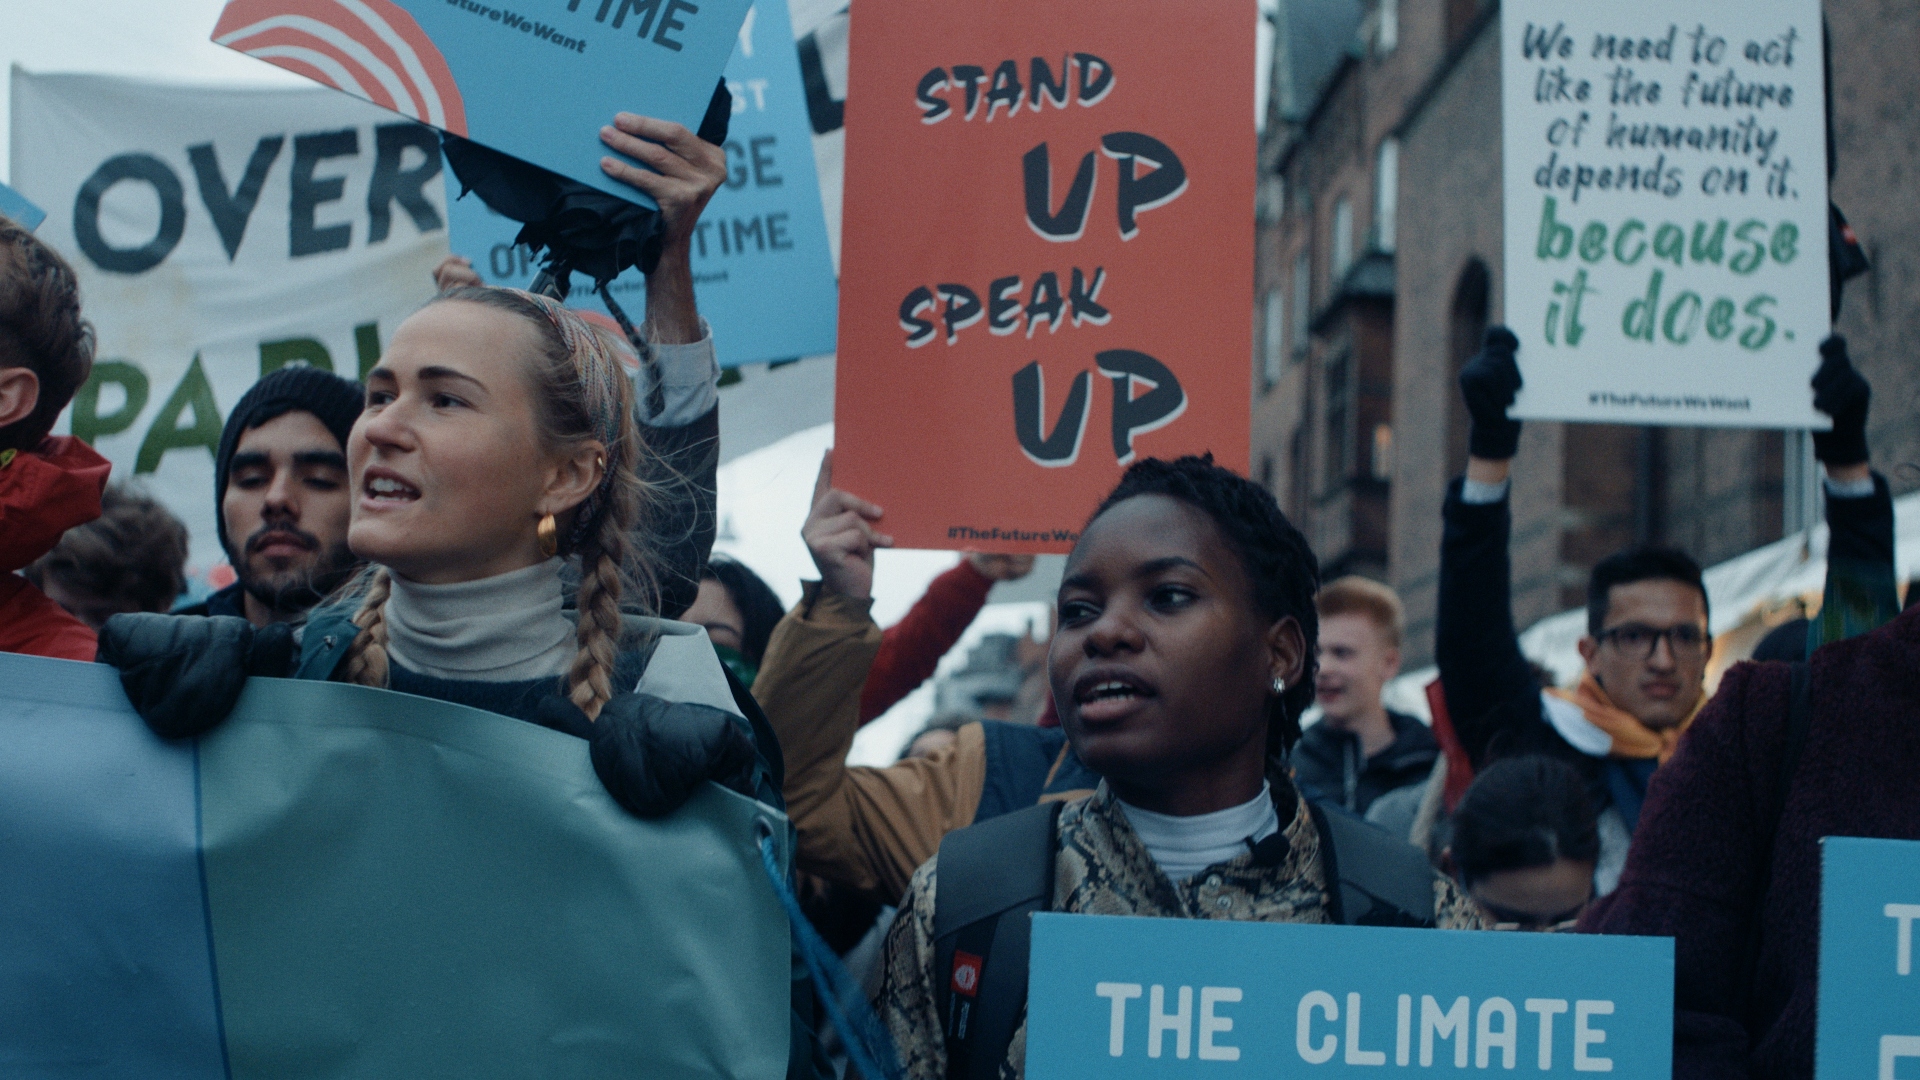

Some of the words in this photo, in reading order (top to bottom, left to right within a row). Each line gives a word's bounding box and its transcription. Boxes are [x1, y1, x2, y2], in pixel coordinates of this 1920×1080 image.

[447, 0, 587, 53] utureWeWant
[1521, 22, 1574, 60] We
[1591, 24, 1677, 63] need
[1687, 25, 1727, 65] to
[1743, 26, 1798, 66] act
[915, 53, 1115, 124] STAND
[1534, 66, 1593, 104] like
[1604, 65, 1662, 106] the
[1681, 69, 1794, 109] future
[1545, 111, 1590, 146] of
[1605, 112, 1778, 167] humanity
[1022, 131, 1188, 242] UP
[1534, 151, 1684, 203] depends
[1700, 165, 1749, 195] on
[1766, 157, 1799, 199] it.
[695, 212, 794, 258] TIME
[1535, 194, 1800, 276] because
[899, 265, 1112, 349] SPEAK
[1544, 268, 1598, 348] it
[1621, 267, 1796, 352] does.
[1012, 348, 1187, 468] UP
[947, 527, 1080, 541] #TheFutureWe
[1095, 982, 1243, 1061] THE
[1296, 990, 1615, 1071] CLIMATE
